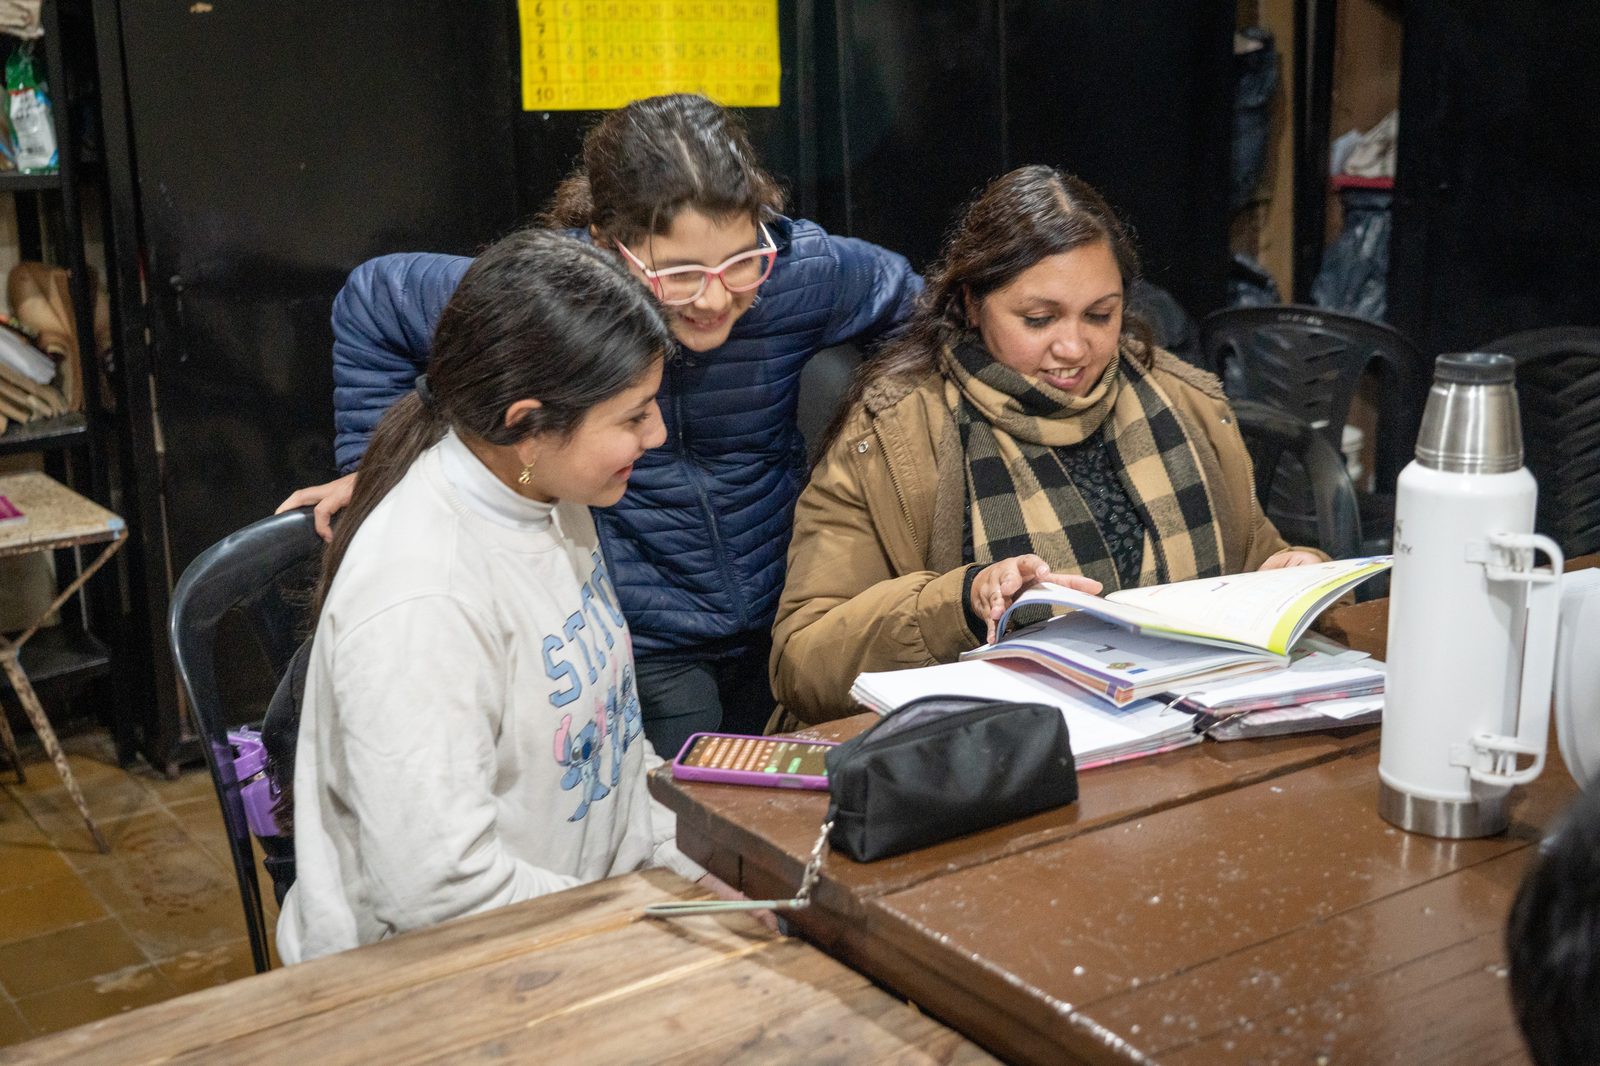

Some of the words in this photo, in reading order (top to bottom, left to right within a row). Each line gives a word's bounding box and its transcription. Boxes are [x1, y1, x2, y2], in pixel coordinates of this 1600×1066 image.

[535, 1, 545, 17] 6
[562, 2, 573, 18] 6
[536, 22, 546, 38] 7
[540, 65, 548, 82] 9
[536, 86, 555, 103] 10
[541, 550, 625, 708] STTC
